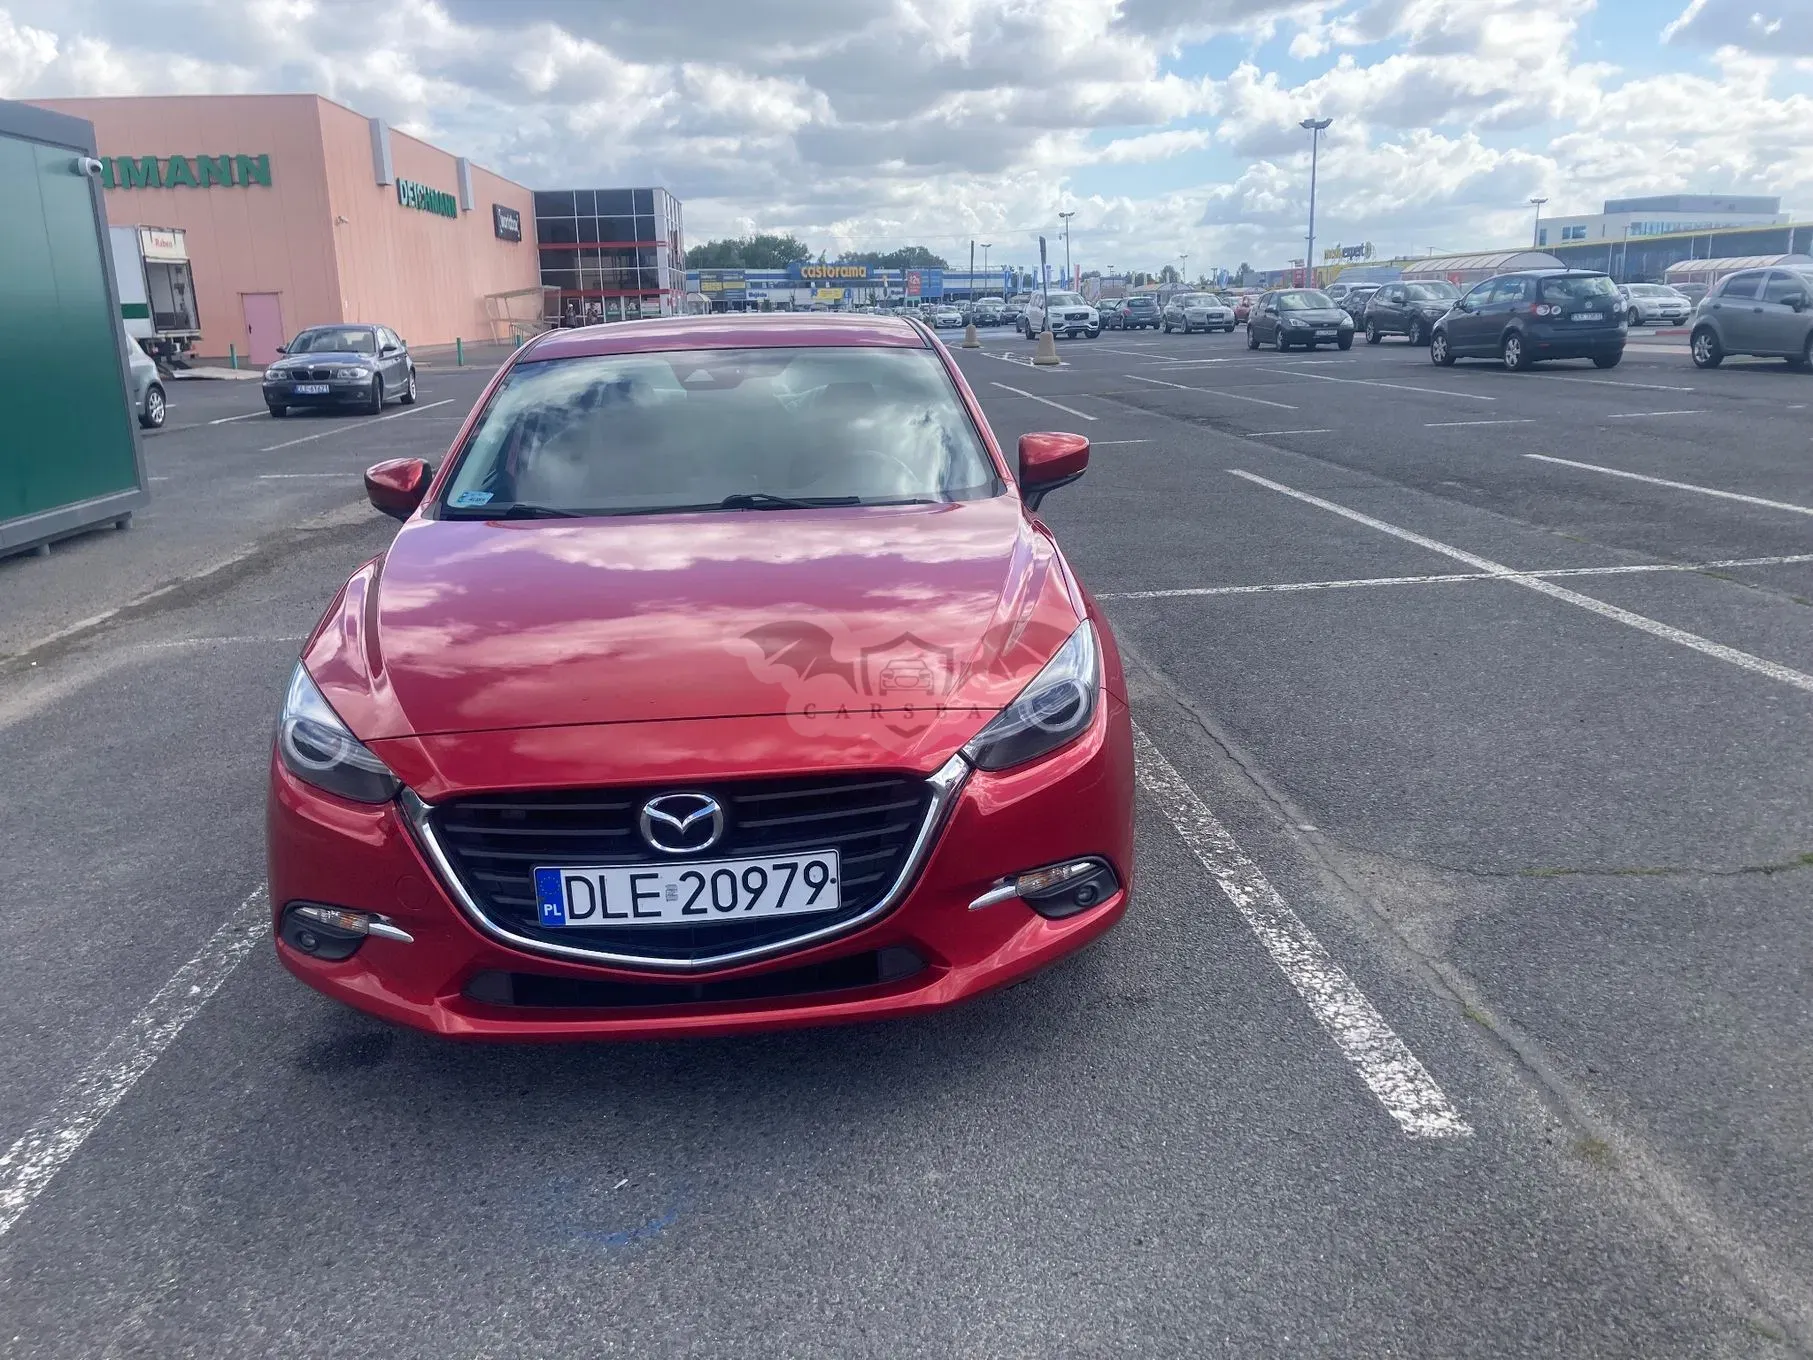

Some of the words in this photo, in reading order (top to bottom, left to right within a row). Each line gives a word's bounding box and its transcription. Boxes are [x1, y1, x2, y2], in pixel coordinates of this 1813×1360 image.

[396, 178, 457, 219] DEICHMANN
[801, 265, 867, 278] castorama
[564, 872, 662, 920] DLE
[679, 860, 831, 916] 20979
[543, 903, 562, 917] PL
